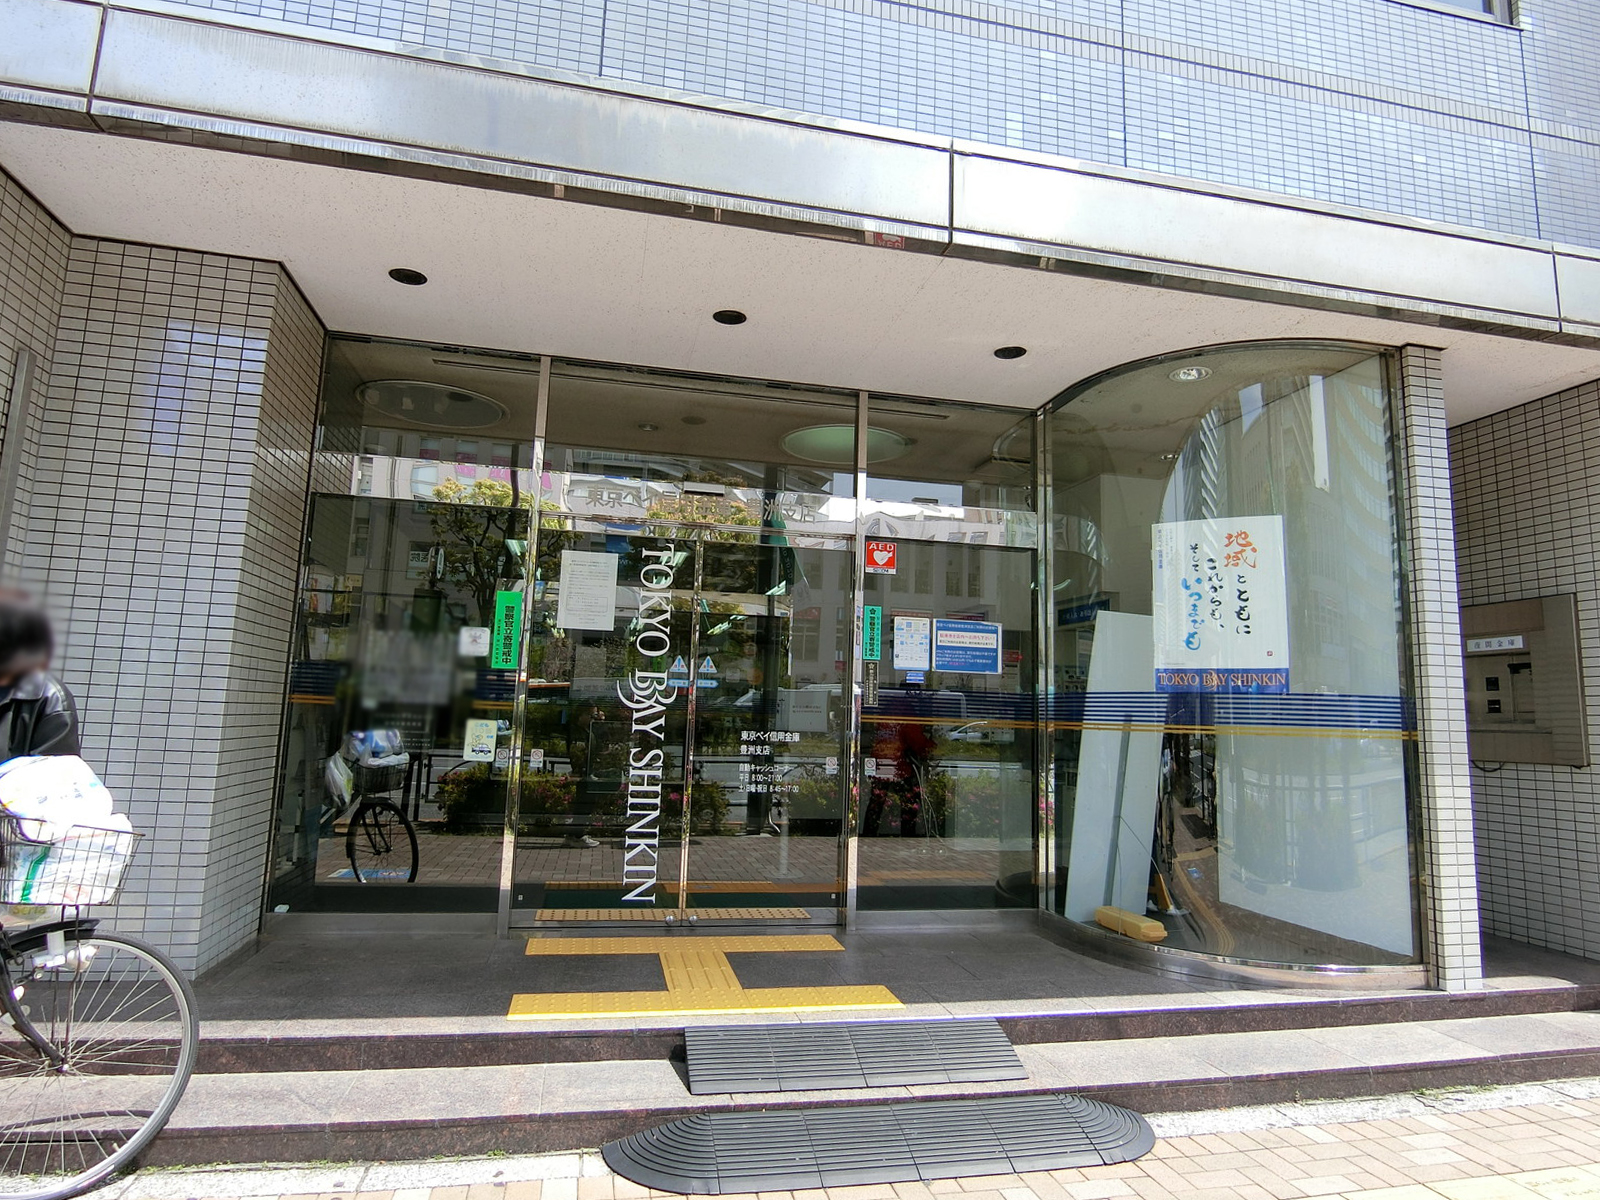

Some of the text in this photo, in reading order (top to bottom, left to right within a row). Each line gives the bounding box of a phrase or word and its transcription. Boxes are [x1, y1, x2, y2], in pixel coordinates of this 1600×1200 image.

[869, 543, 894, 551] AED
[636, 543, 675, 657] TOKYO
[1224, 530, 1258, 635] 地域とともに
[501, 605, 515, 664] 警察官立寄警戒中
[616, 668, 679, 741] BAY
[1158, 669, 1287, 691] TOKYO BAY SHINKIN
[740, 730, 800, 742] 東京ベイ信用金庫
[740, 745, 771, 755] 豊洲支店
[621, 748, 664, 904] SHINKIN
